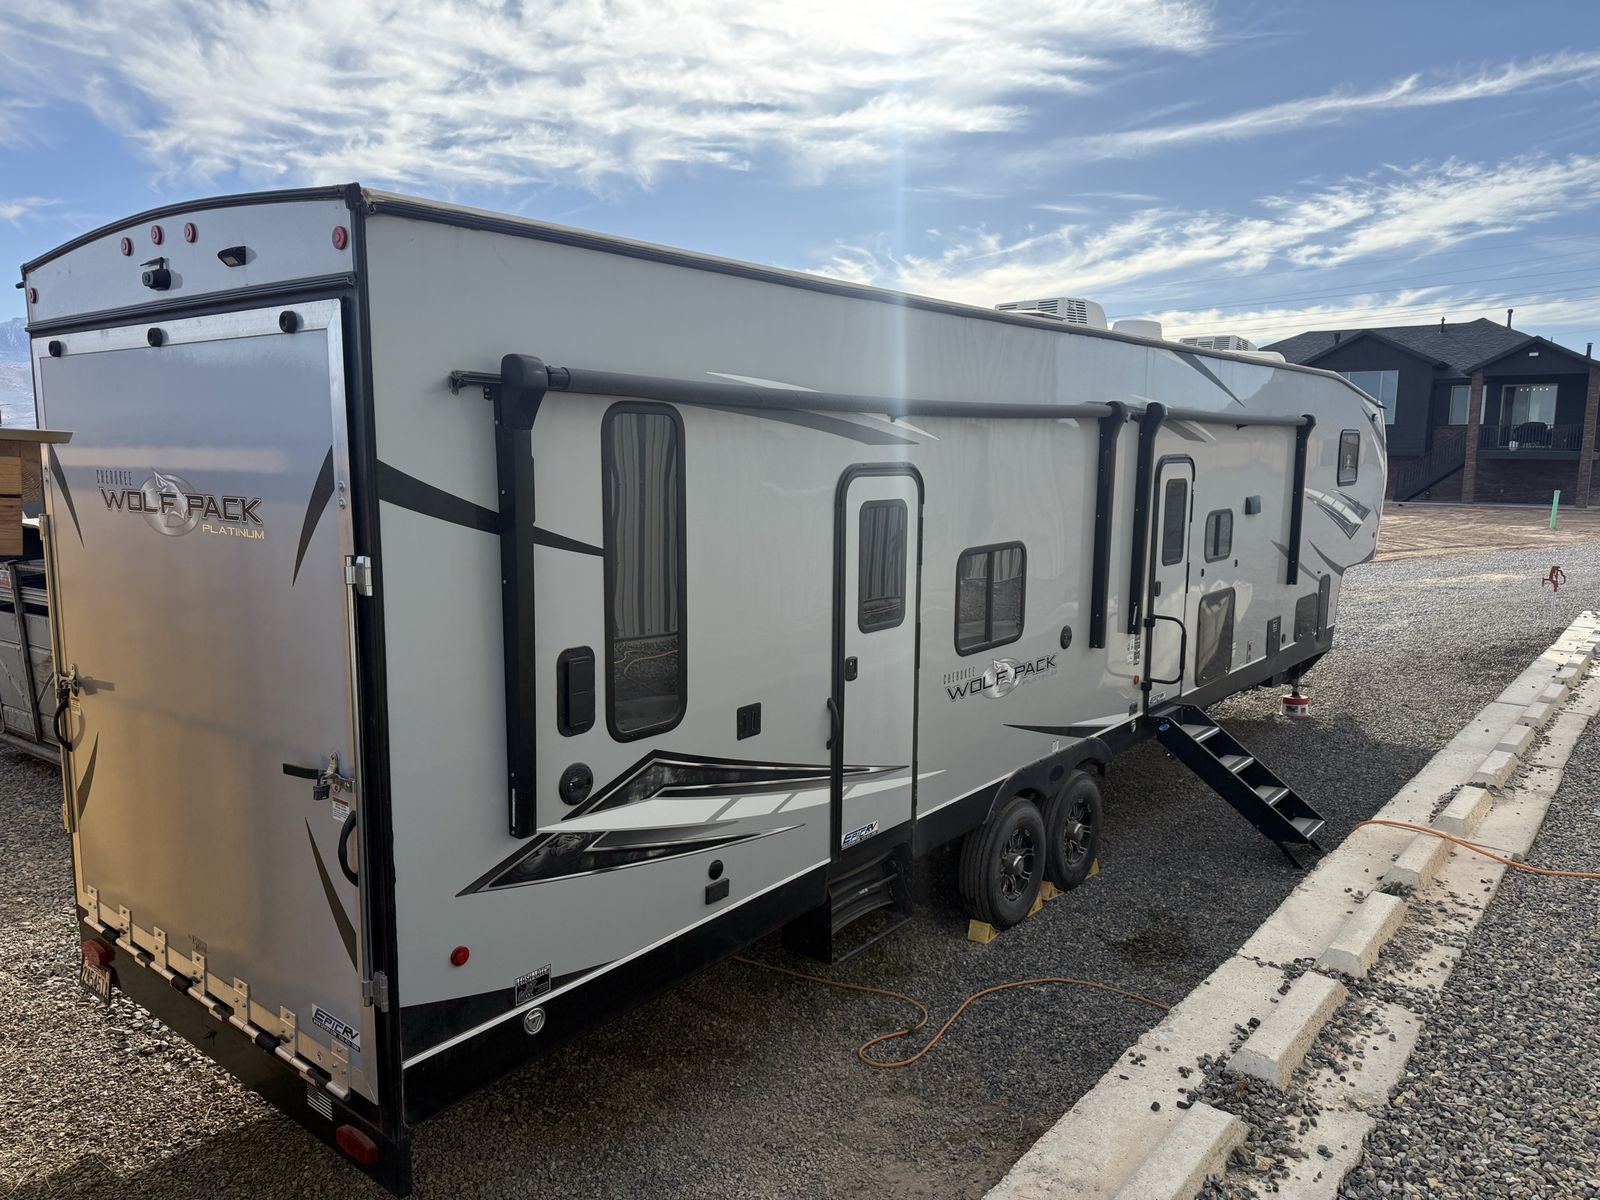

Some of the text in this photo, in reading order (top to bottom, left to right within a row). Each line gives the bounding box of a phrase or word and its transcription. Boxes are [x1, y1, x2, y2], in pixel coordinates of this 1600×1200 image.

[96, 469, 132, 486] CHEROKEE
[99, 487, 264, 525] WOLF PACK
[202, 524, 265, 540] PLATINUM
[943, 666, 976, 685] CHEROKEE
[945, 669, 1008, 702] WOLF
[1013, 653, 1058, 679] PACK
